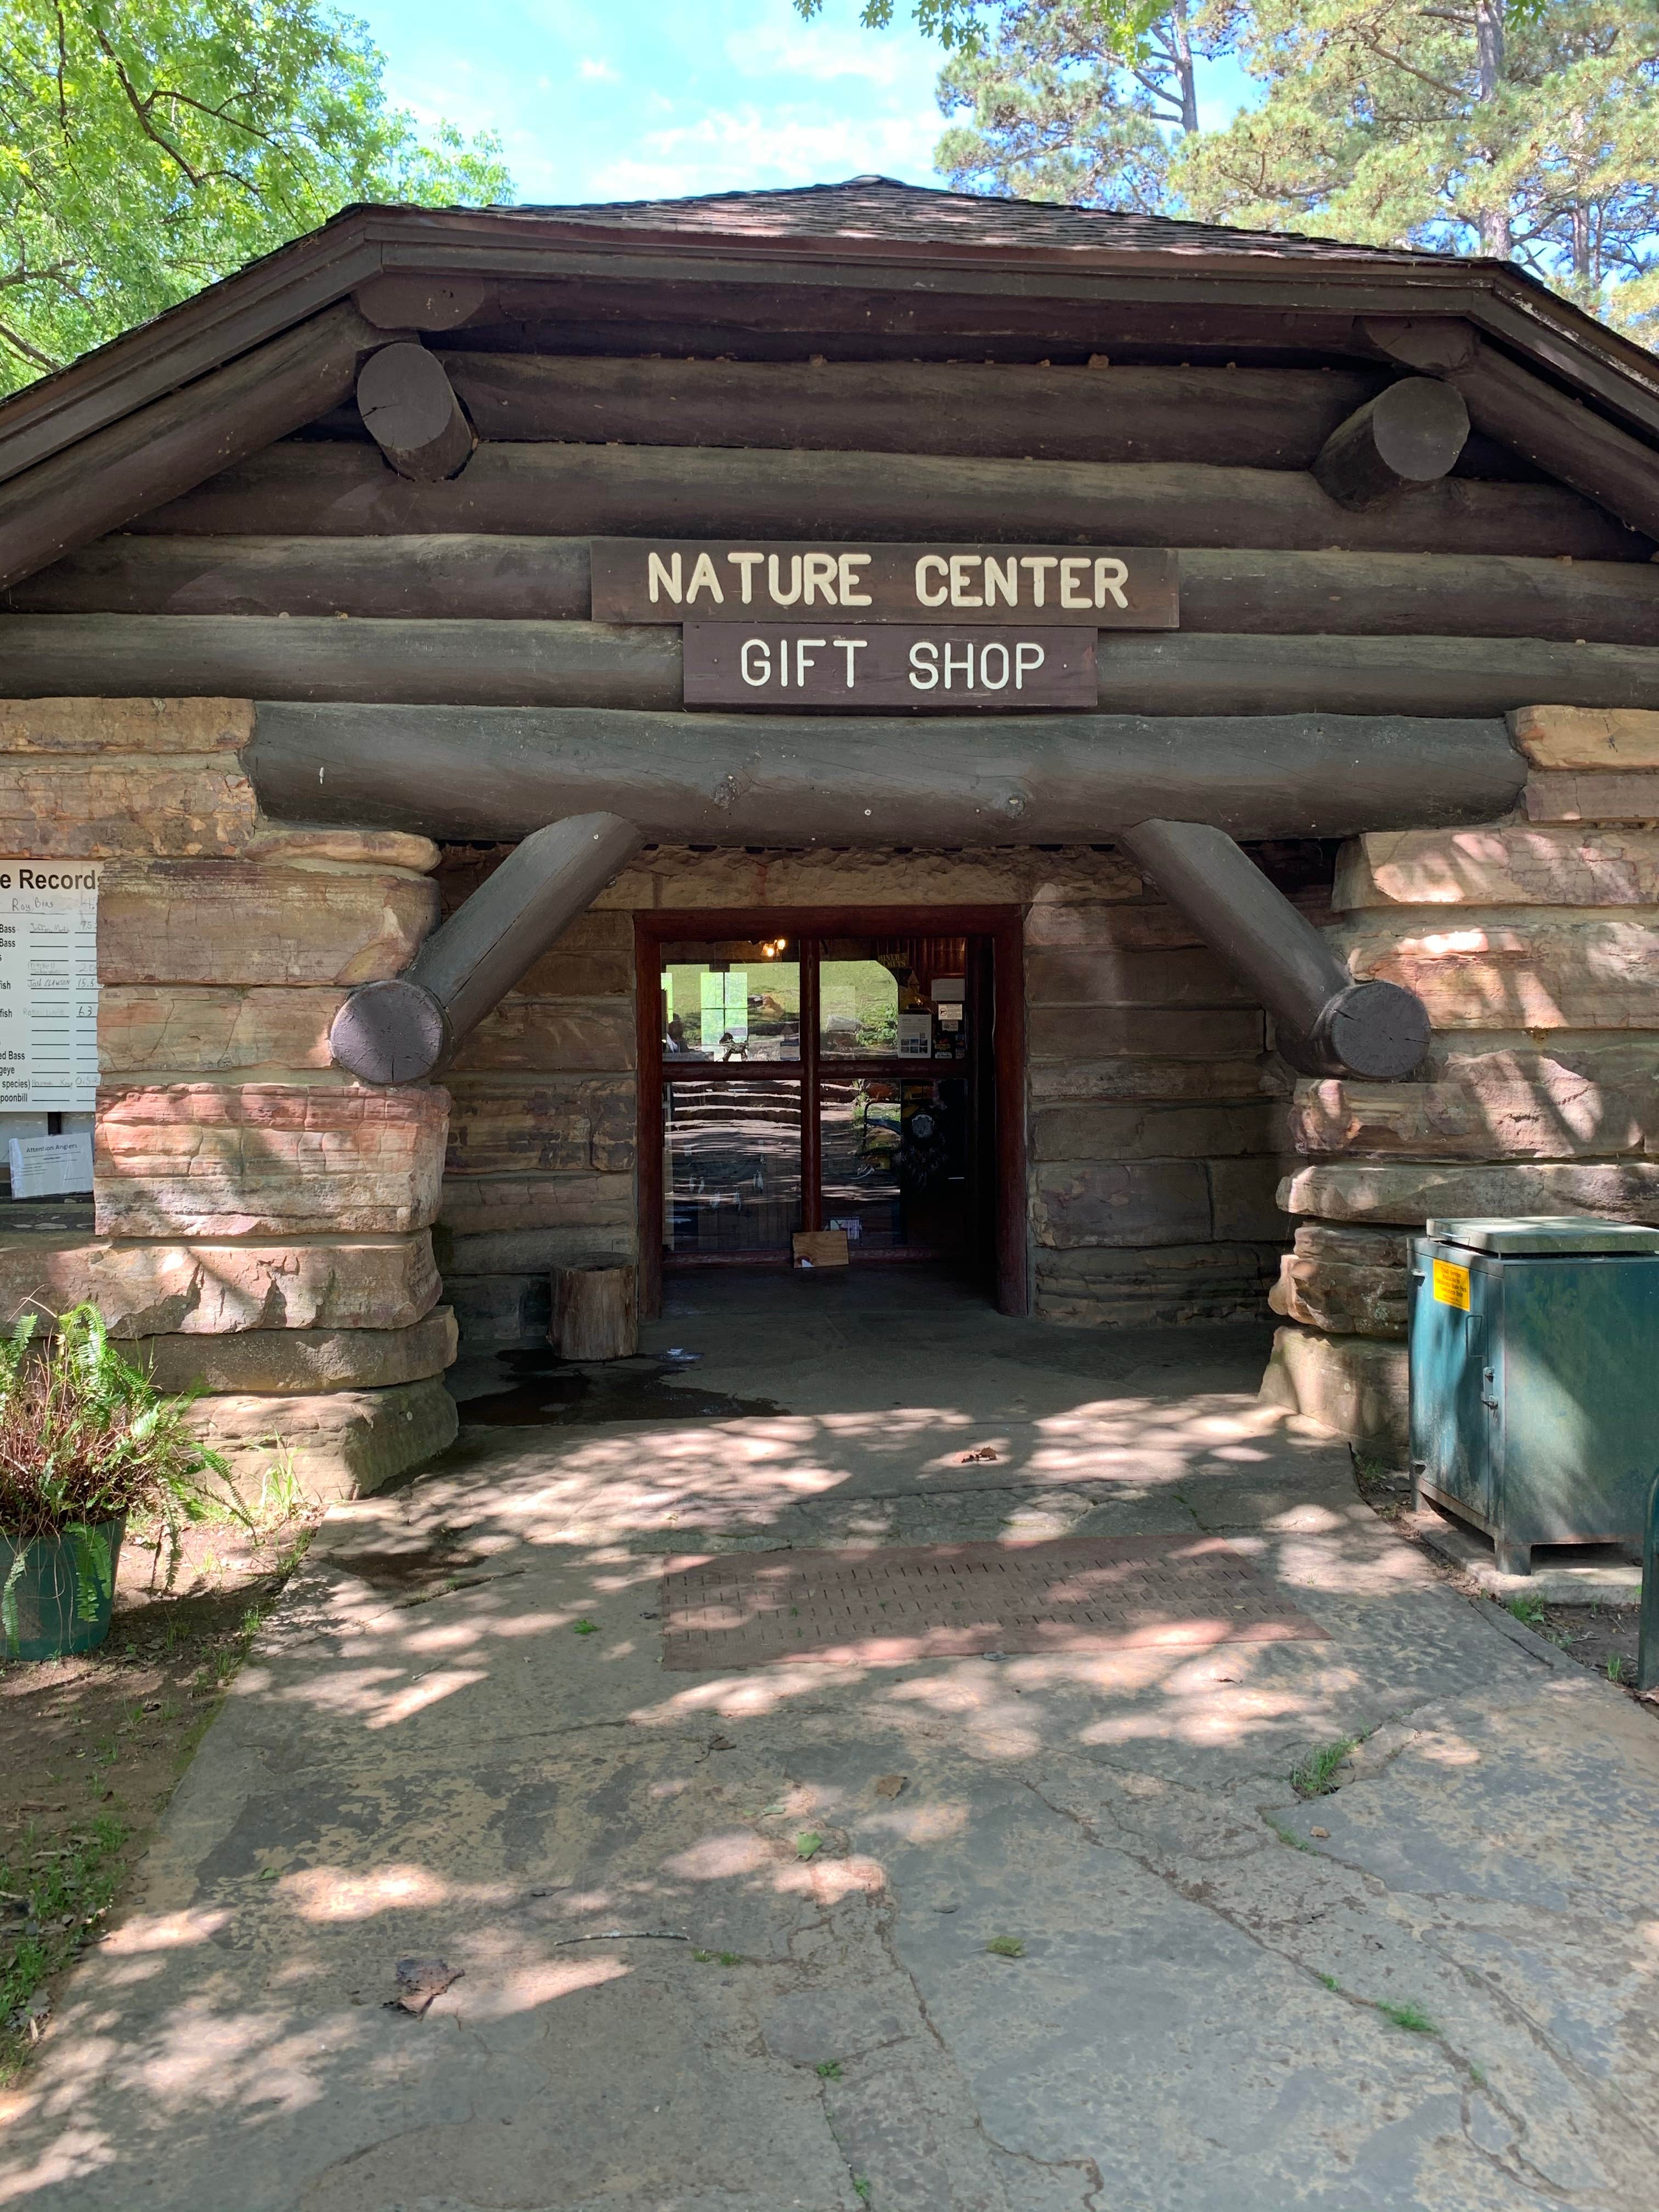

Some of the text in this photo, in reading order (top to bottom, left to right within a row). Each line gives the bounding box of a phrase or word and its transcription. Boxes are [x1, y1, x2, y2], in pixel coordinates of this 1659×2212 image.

[648, 552, 1129, 608] NATURE CENTER
[741, 639, 1045, 690] GIFT SHOP
[20, 869, 99, 890] Record
[0, 924, 16, 933] Bass
[0, 938, 16, 947] Bass
[26, 978, 42, 988] Josh
[9, 1051, 25, 1060] Bass
[2, 1079, 30, 1091] species)
